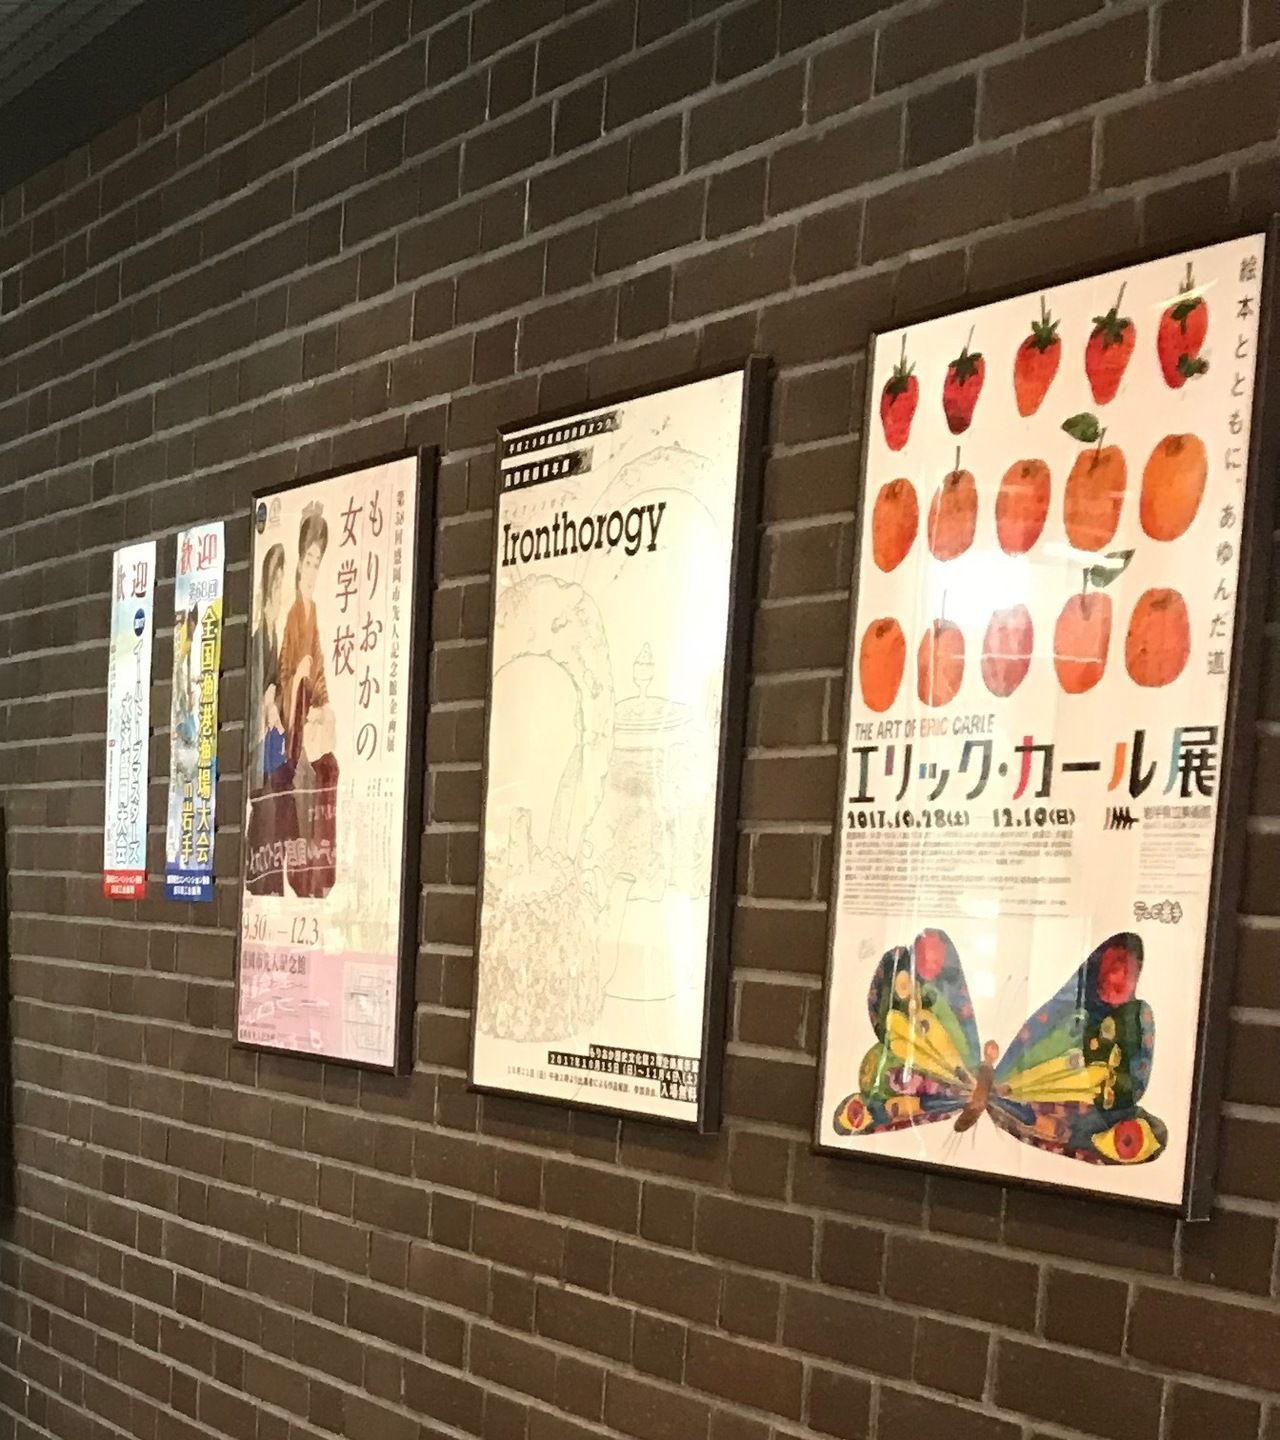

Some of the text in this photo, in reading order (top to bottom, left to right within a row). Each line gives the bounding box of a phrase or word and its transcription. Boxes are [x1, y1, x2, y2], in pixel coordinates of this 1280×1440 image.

[332, 496, 363, 677] 女学校
[502, 502, 667, 567] Ironthorogy
[356, 489, 384, 763] もりおかの
[196, 605, 219, 866] 全国漁港漁場大会
[848, 724, 1220, 803] エリック・カール展
[855, 714, 996, 741] THE ART OF ERIC CARLE
